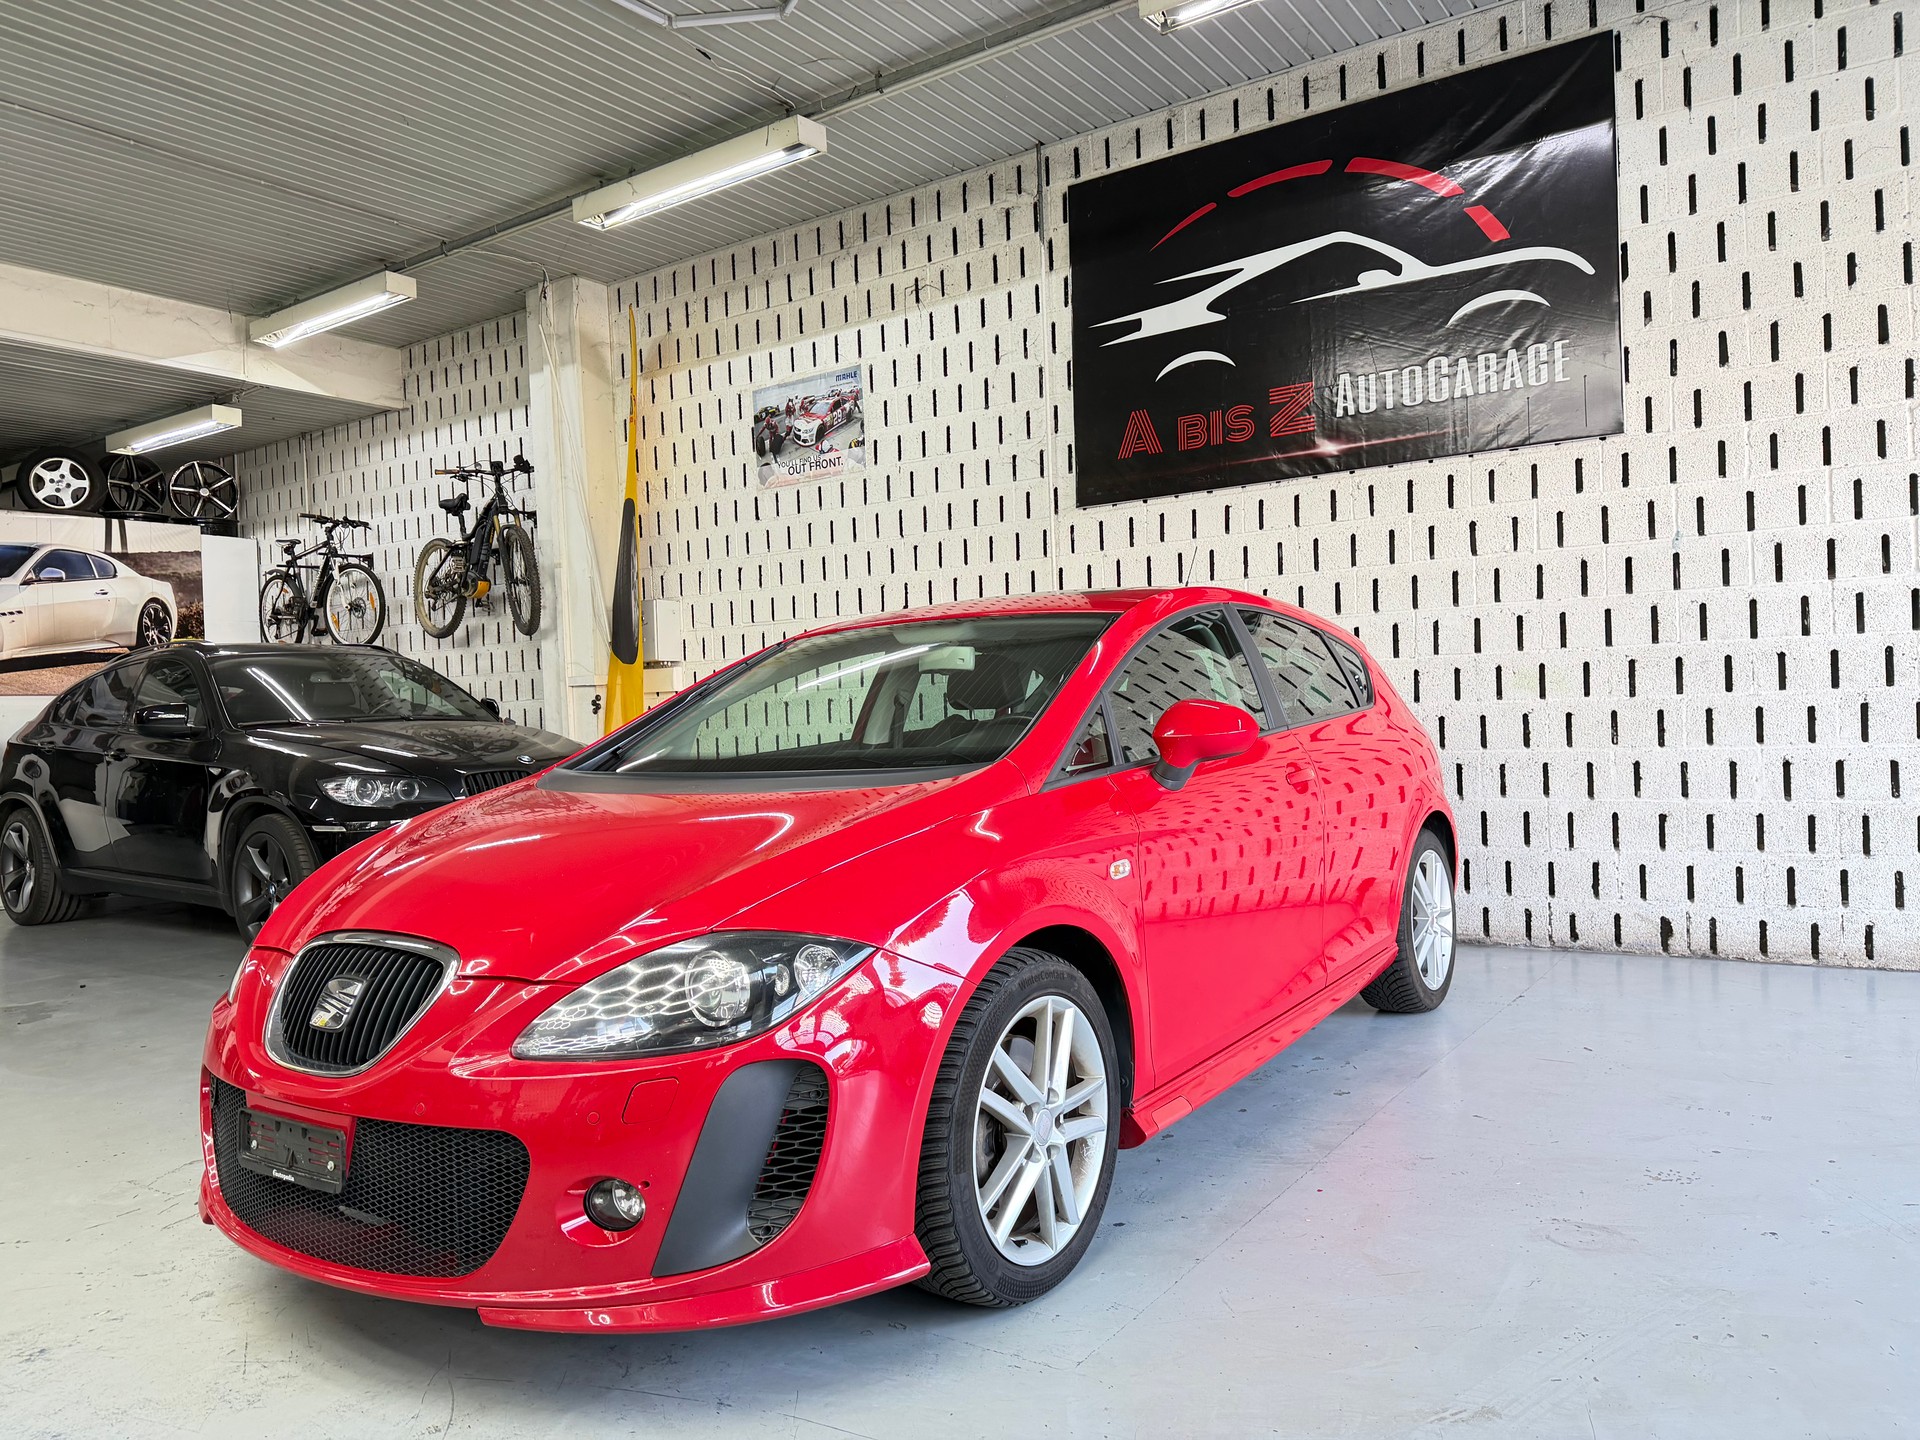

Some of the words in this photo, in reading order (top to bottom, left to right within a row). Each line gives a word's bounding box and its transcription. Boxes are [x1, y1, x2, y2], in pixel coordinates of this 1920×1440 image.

[835, 370, 858, 382] MAHLE
[833, 409, 842, 424] 29
[1117, 408, 1163, 460] A
[1268, 381, 1316, 438] Z
[788, 463, 806, 475] OUT
[809, 456, 843, 471] FRONT.
